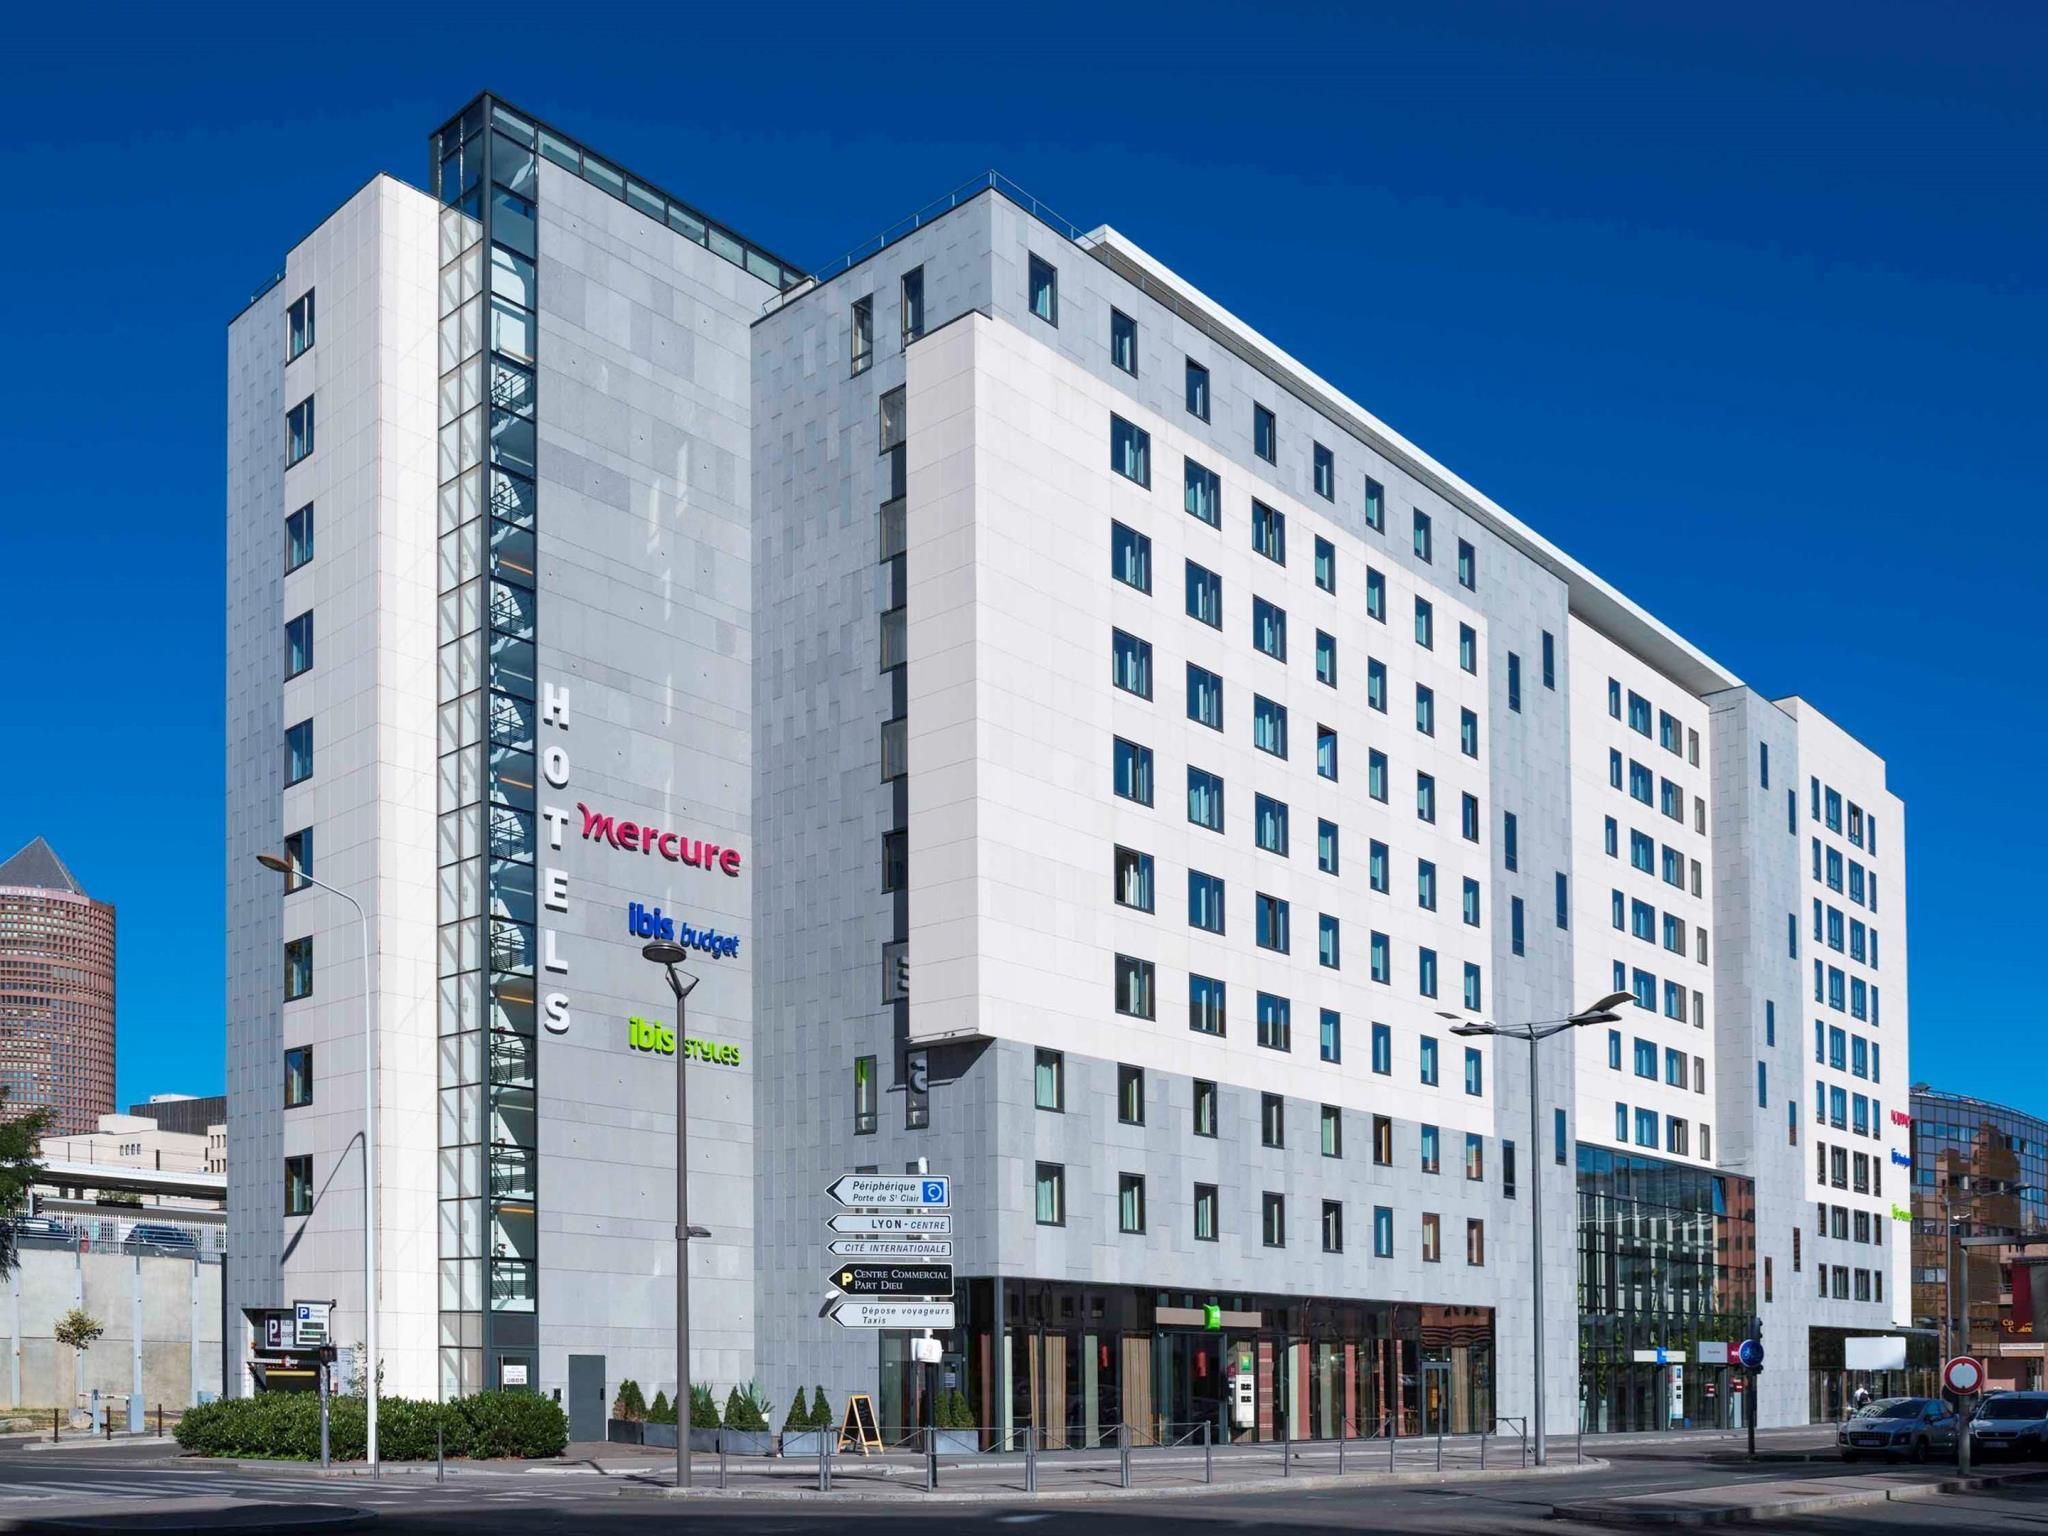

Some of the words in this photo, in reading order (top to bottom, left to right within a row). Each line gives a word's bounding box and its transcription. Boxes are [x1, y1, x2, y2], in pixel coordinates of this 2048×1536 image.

[543, 682, 570, 1035] HOTELS
[628, 902, 675, 941] ibis
[680, 922, 741, 960] budget
[628, 1015, 676, 1056] ibis
[852, 1181, 916, 1193] Périphérique
[853, 1194, 874, 1202] Porte
[877, 1194, 887, 1202] de
[900, 1194, 920, 1202] Clair
[844, 1243, 865, 1252] CITÉ
[870, 1244, 946, 1253] INTERNATIONALE
[861, 1307, 896, 1316] Dépose
[901, 1308, 950, 1317] voyageurs
[863, 1317, 886, 1325] Taxis
